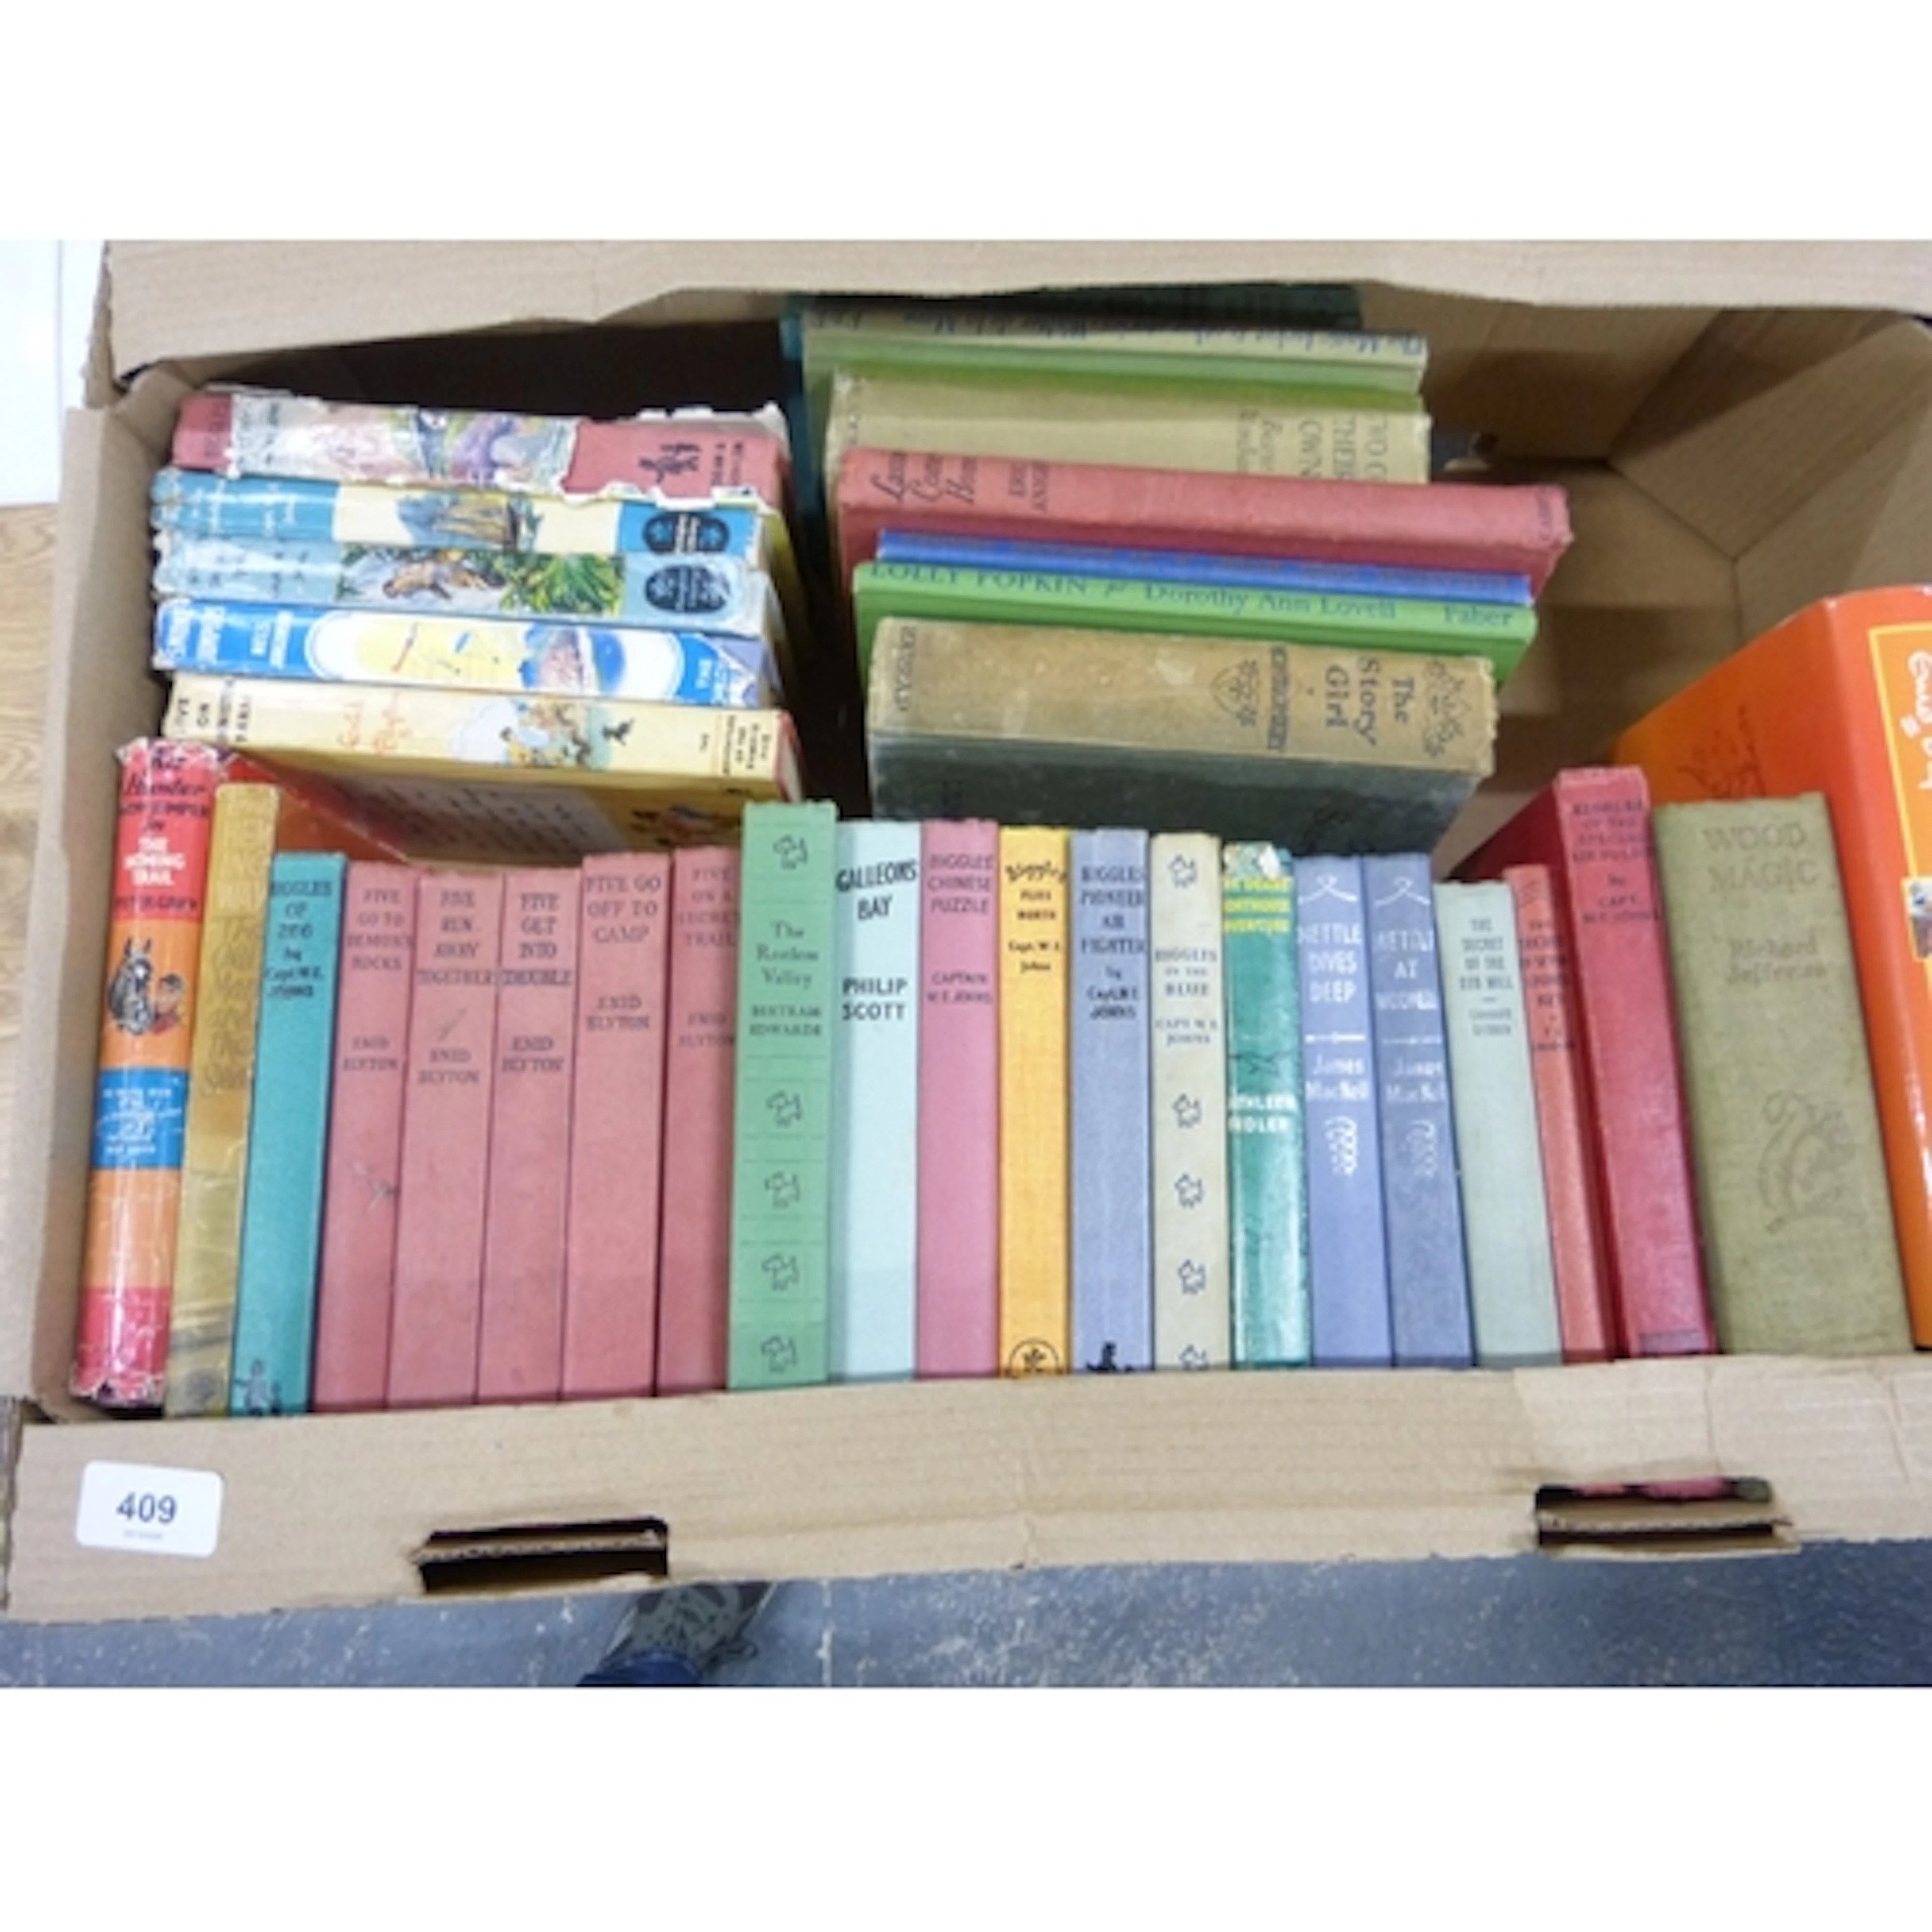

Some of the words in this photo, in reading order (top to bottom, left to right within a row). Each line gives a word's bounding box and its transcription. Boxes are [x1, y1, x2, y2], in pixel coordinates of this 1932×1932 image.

[870, 564, 959, 585] LOLLY
[976, 570, 1090, 596] POPKIN
[1145, 582, 1250, 615] Dorothy
[1258, 591, 1311, 614] Ann
[1320, 596, 1397, 620] Lovell
[1442, 606, 1515, 628] Faber
[1324, 664, 1349, 729] Girl
[1353, 656, 1383, 747] Story
[1392, 675, 1415, 725] The
[1703, 823, 1808, 851] WOOD
[835, 859, 917, 894] GALLEONS
[1708, 857, 1818, 891] MAGIC
[584, 875, 630, 894] FIVE
[633, 874, 662, 892] GO
[927, 875, 992, 893] CHINESE
[362, 889, 400, 905] FIVE
[521, 892, 561, 912] FIVE
[931, 897, 990, 914] PUZZLE
[285, 901, 308, 918] OF
[587, 900, 623, 918] OFF
[630, 900, 658, 917] TO
[856, 894, 894, 922] BAY
[358, 913, 379, 927] GO
[383, 913, 405, 927] TO
[440, 917, 473, 933] RUN
[521, 916, 557, 935] GET
[1470, 917, 1493, 932] THE
[592, 925, 650, 944] CAMP
[771, 920, 805, 940] The
[1308, 950, 1357, 974] DIVES
[1394, 959, 1419, 980] AT
[761, 968, 814, 990] Valley
[842, 977, 909, 997] PHILIP
[931, 971, 989, 986] CAPTAIN
[1165, 983, 1209, 998] BLUE
[1309, 980, 1357, 1005] DEEP
[598, 994, 642, 1010] ENID
[841, 1003, 907, 1022] SCOTT
[586, 1015, 651, 1032] BLYTON
[512, 1036, 554, 1052] ENID
[418, 1070, 480, 1085] BLYTON
[116, 1491, 178, 1526] 409
